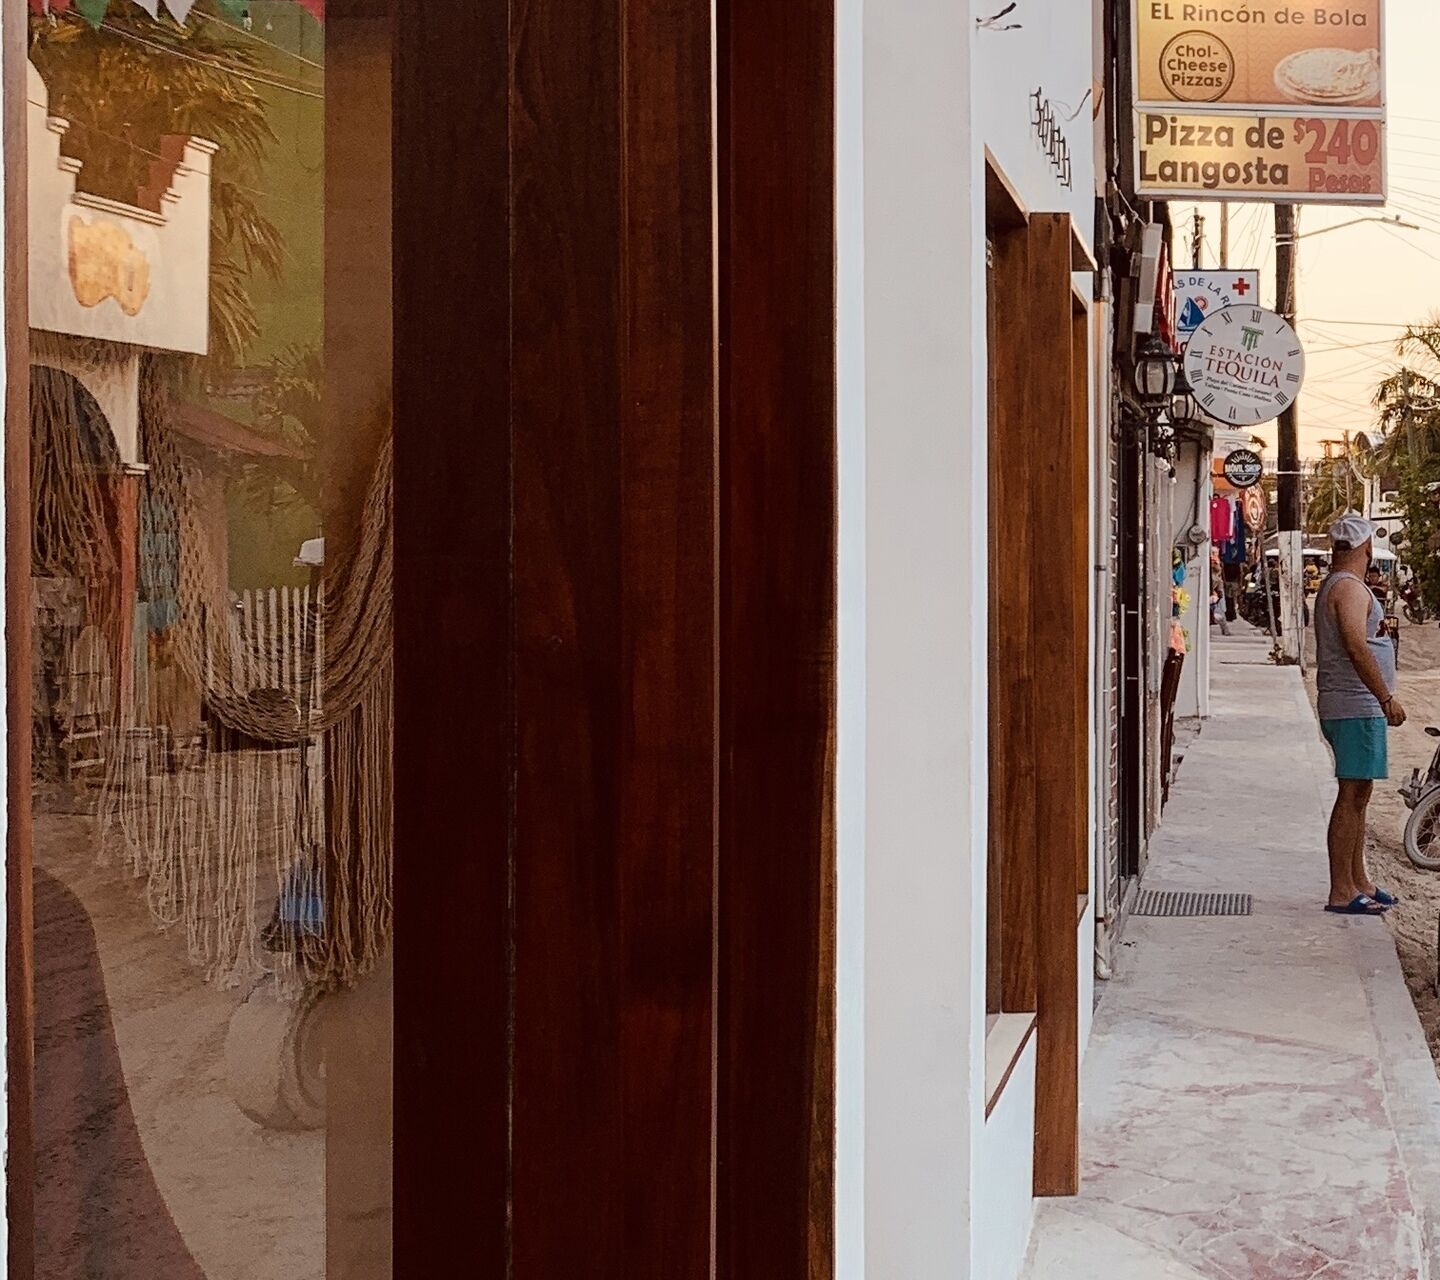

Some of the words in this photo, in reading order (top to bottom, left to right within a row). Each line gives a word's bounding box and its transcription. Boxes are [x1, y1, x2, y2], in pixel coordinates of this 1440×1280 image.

[1151, 2, 1174, 20] EL
[1183, 3, 1265, 24] Rincón
[1274, 7, 1305, 25] de
[1314, 8, 1367, 26] Bola
[1167, 58, 1228, 73] Cheese
[1171, 73, 1223, 88] Pizzas
[1145, 114, 1234, 148] Pizza
[1245, 117, 1285, 149] de
[1293, 117, 1378, 166] $240
[1139, 150, 1289, 189] Langosta
[1308, 167, 1372, 193] Pesos
[1189, 276, 1205, 287] DE
[1207, 282, 1221, 296] LA
[1210, 345, 1283, 371] ESTACIÓN
[1205, 357, 1279, 388] TEQUILA
